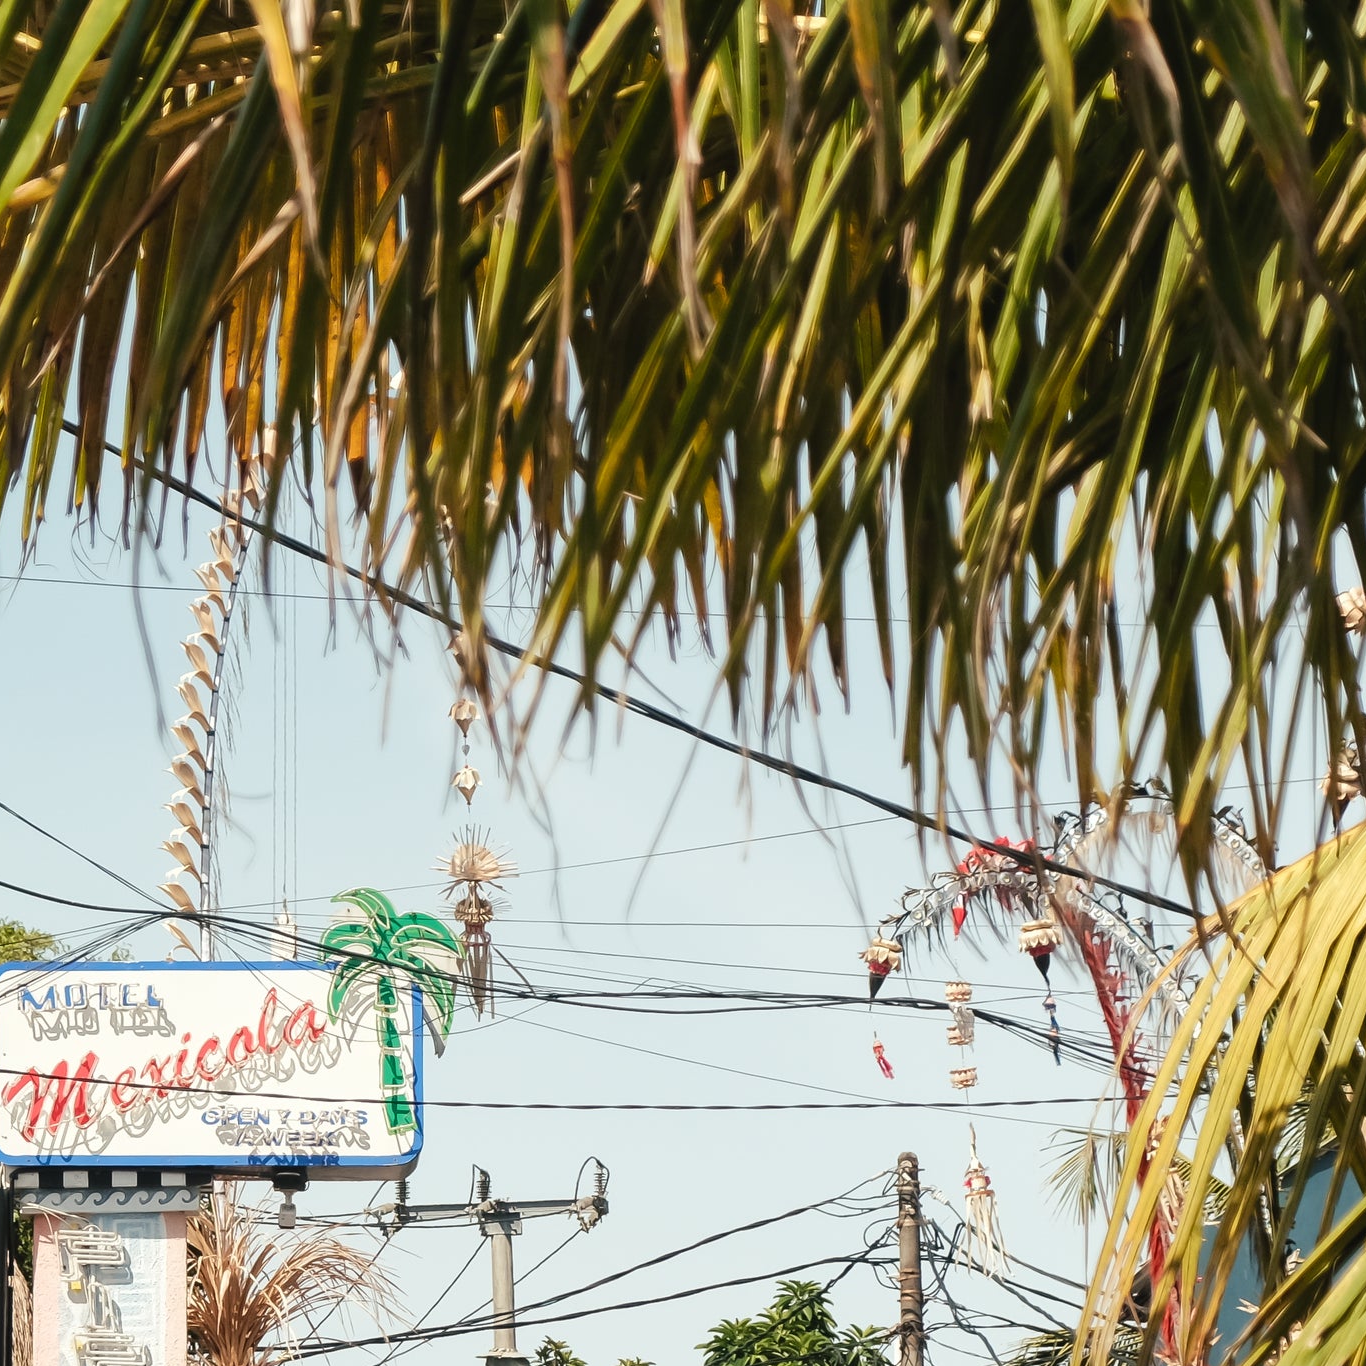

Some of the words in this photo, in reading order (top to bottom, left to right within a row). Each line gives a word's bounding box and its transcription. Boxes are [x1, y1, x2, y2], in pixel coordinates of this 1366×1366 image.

[18, 983, 164, 1011] MOTEL
[1, 987, 326, 1142] Mexicola
[201, 1106, 270, 1126] OPEN
